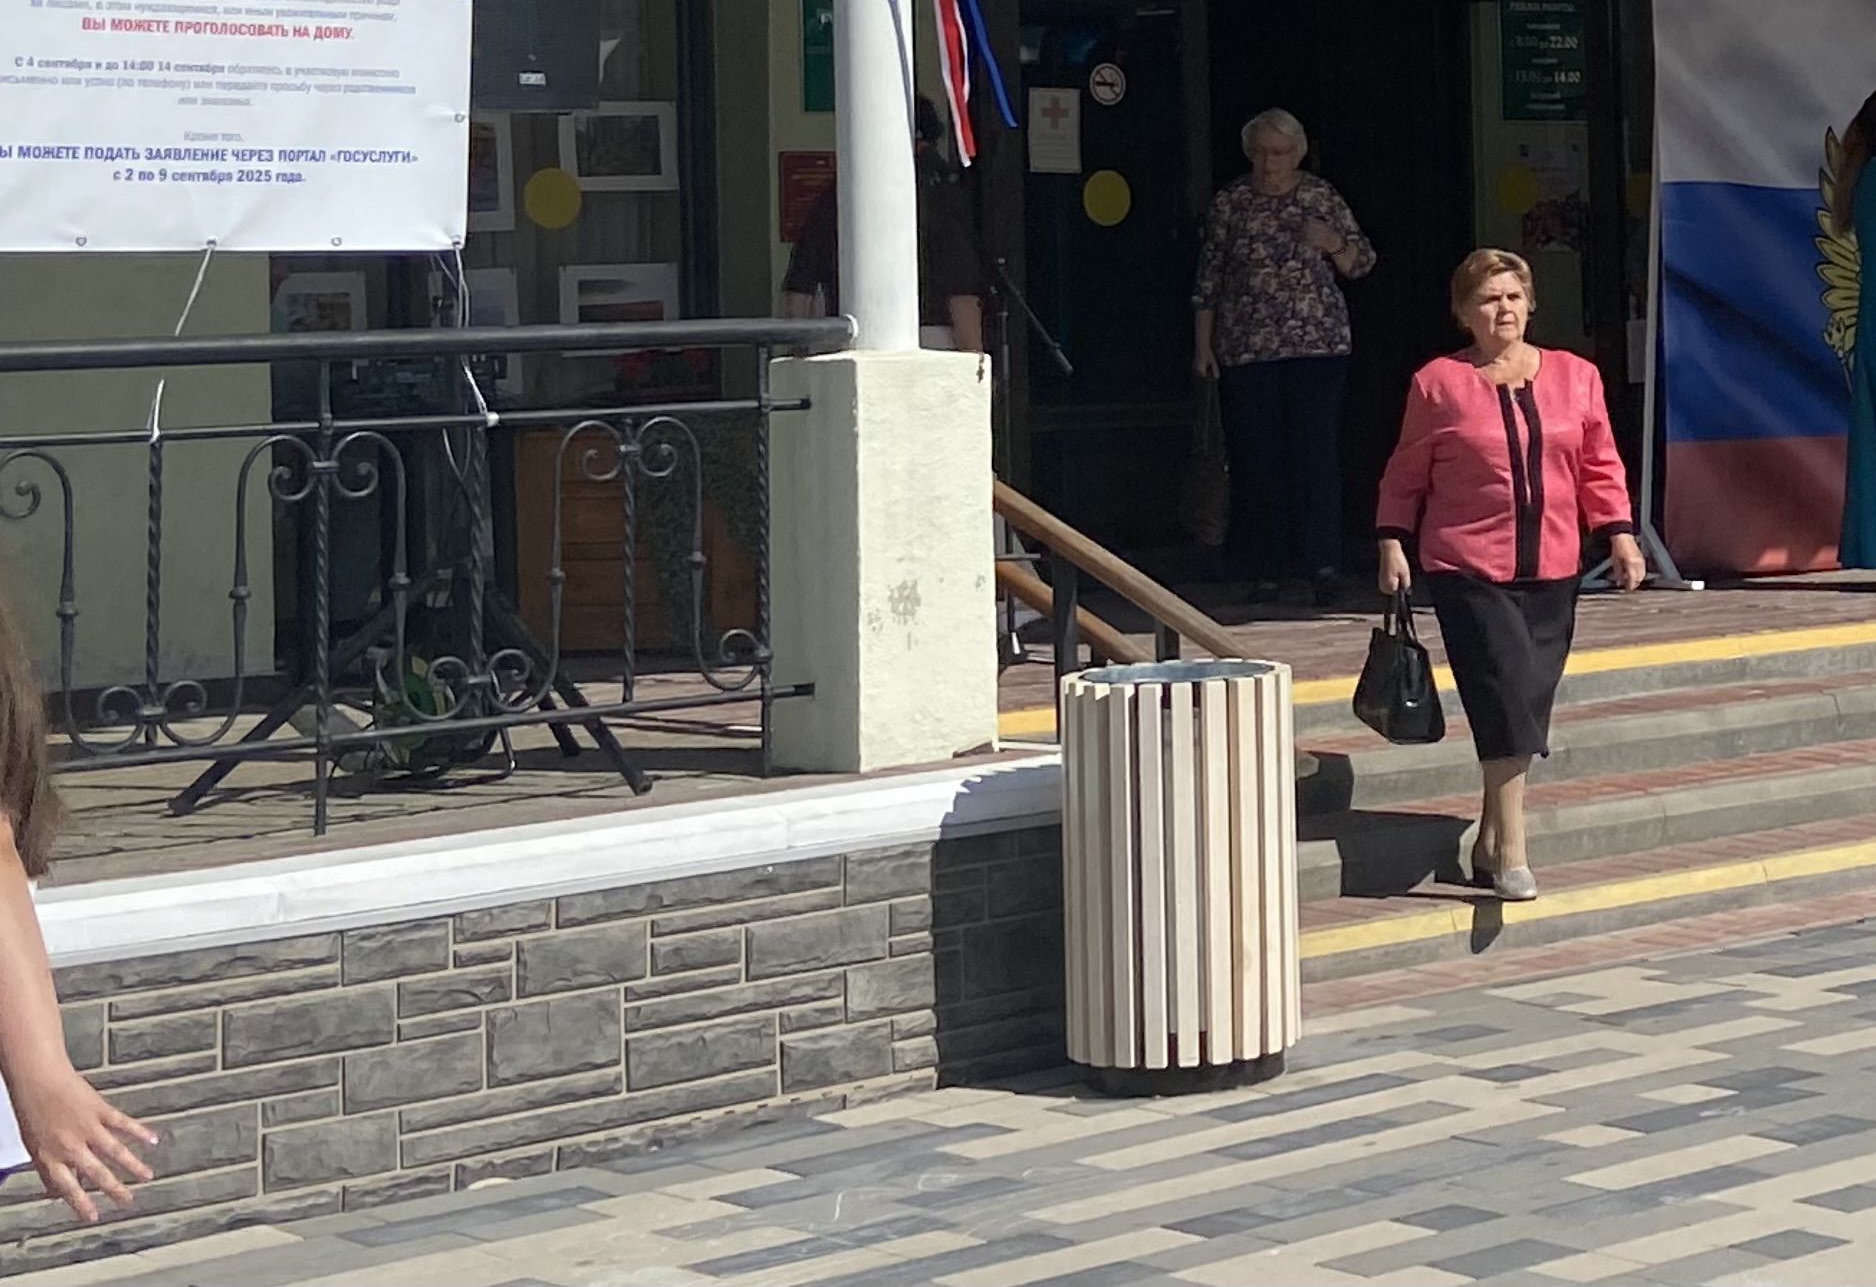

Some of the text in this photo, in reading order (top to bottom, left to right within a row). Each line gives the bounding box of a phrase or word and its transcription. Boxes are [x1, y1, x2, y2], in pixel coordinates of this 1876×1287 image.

[82, 17, 106, 31] ВЫ
[110, 18, 169, 34] МОЖЕТЕ
[174, 20, 289, 38] ПРОГОЛОСОВАТЬ
[293, 25, 311, 38] НА
[0, 146, 419, 164] Ы МОЖЕТЕ ПОДАТЬ ЗАЯВЛЕНИЕ ЧЕРЕЗ ПОРТАЛ «ГОСУСЛУГИ»
[124, 168, 134, 181] 2
[159, 168, 168, 182] 9
[237, 169, 272, 182] 2025
